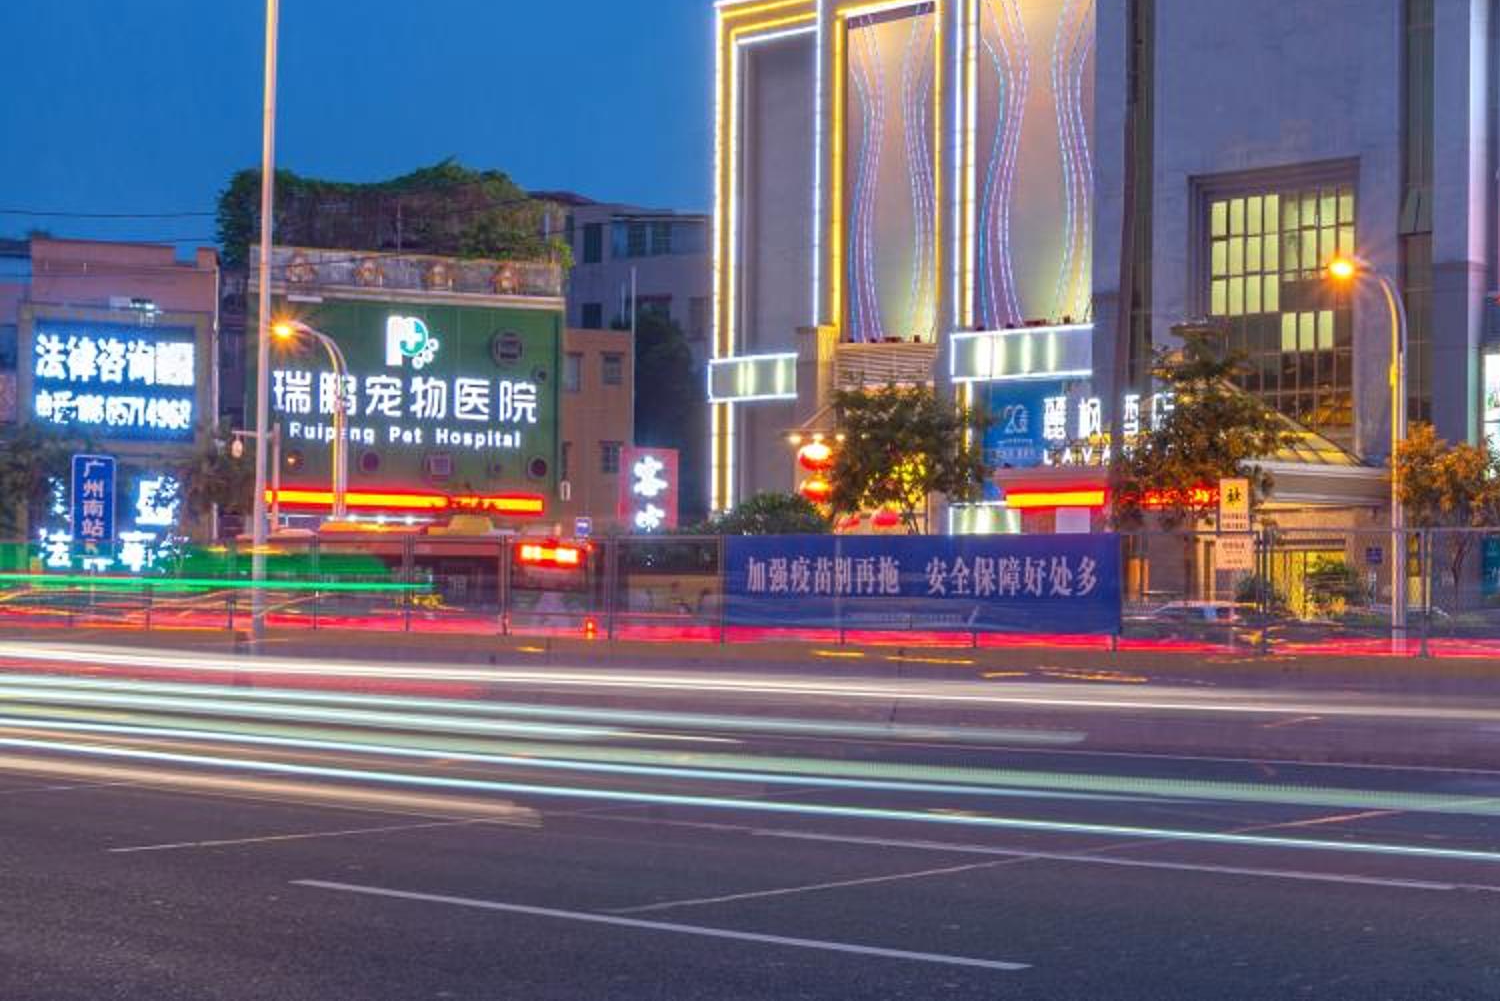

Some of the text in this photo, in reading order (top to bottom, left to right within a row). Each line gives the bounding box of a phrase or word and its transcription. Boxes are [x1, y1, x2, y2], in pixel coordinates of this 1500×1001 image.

[273, 370, 537, 423] 瑞鹏宠物医院
[389, 425, 422, 444] Pet
[436, 429, 521, 450] Hospital
[82, 460, 105, 537] 广州南站
[925, 556, 1098, 597] 安全保障好处多
